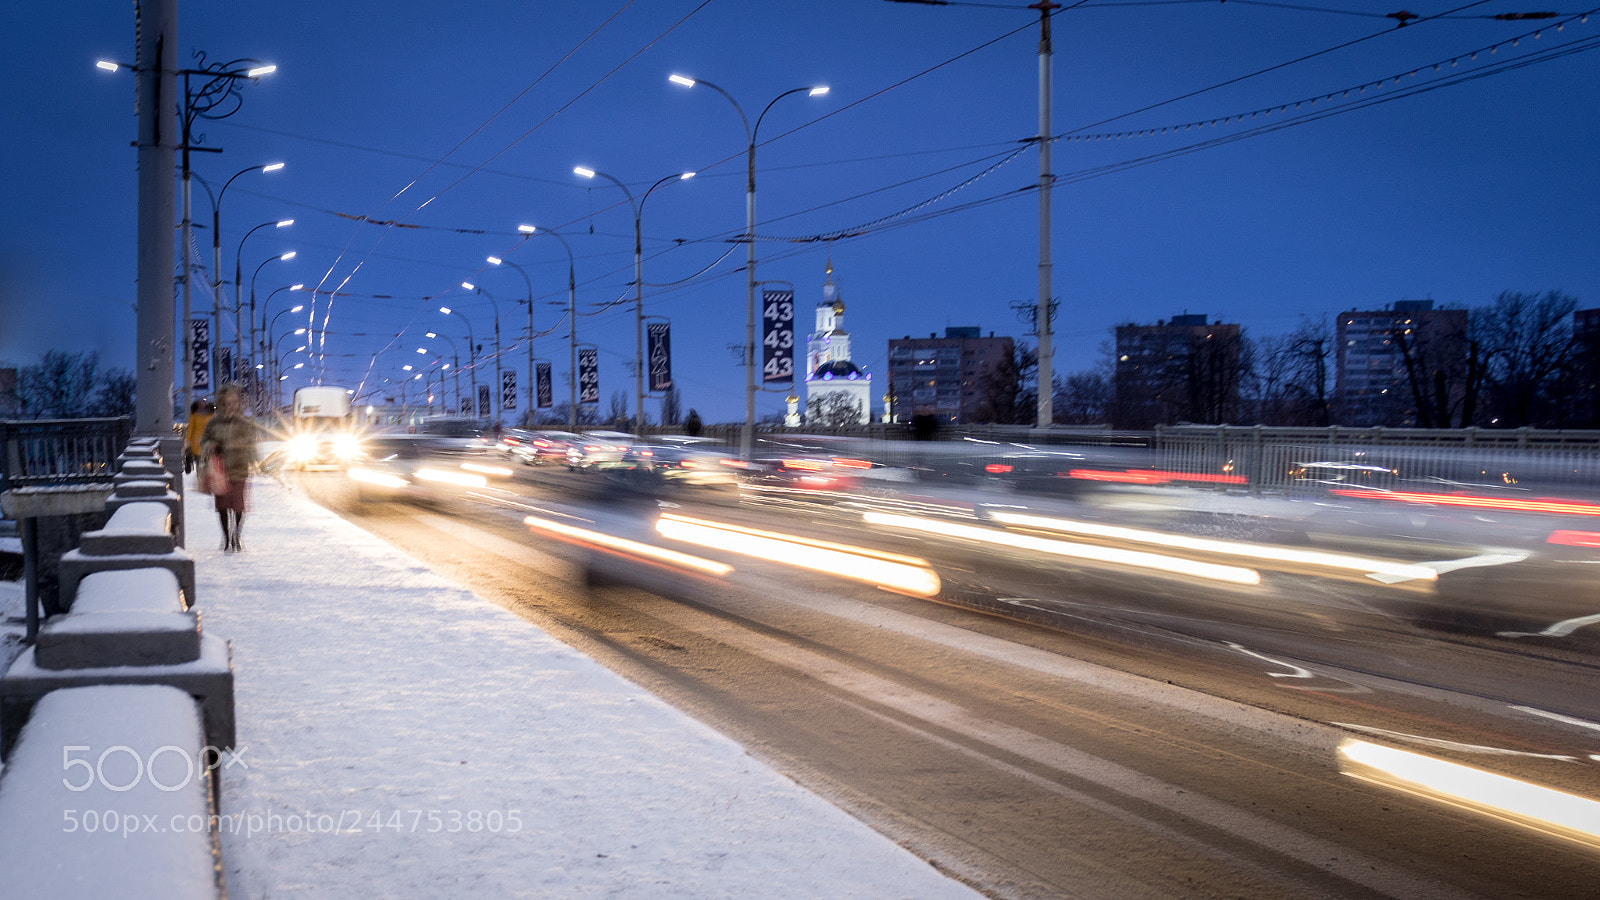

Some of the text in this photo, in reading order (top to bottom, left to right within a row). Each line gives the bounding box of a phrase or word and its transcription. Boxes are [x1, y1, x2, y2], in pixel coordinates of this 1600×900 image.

[764, 302, 794, 321] 43
[764, 329, 794, 349] 43
[764, 357, 794, 376] 43
